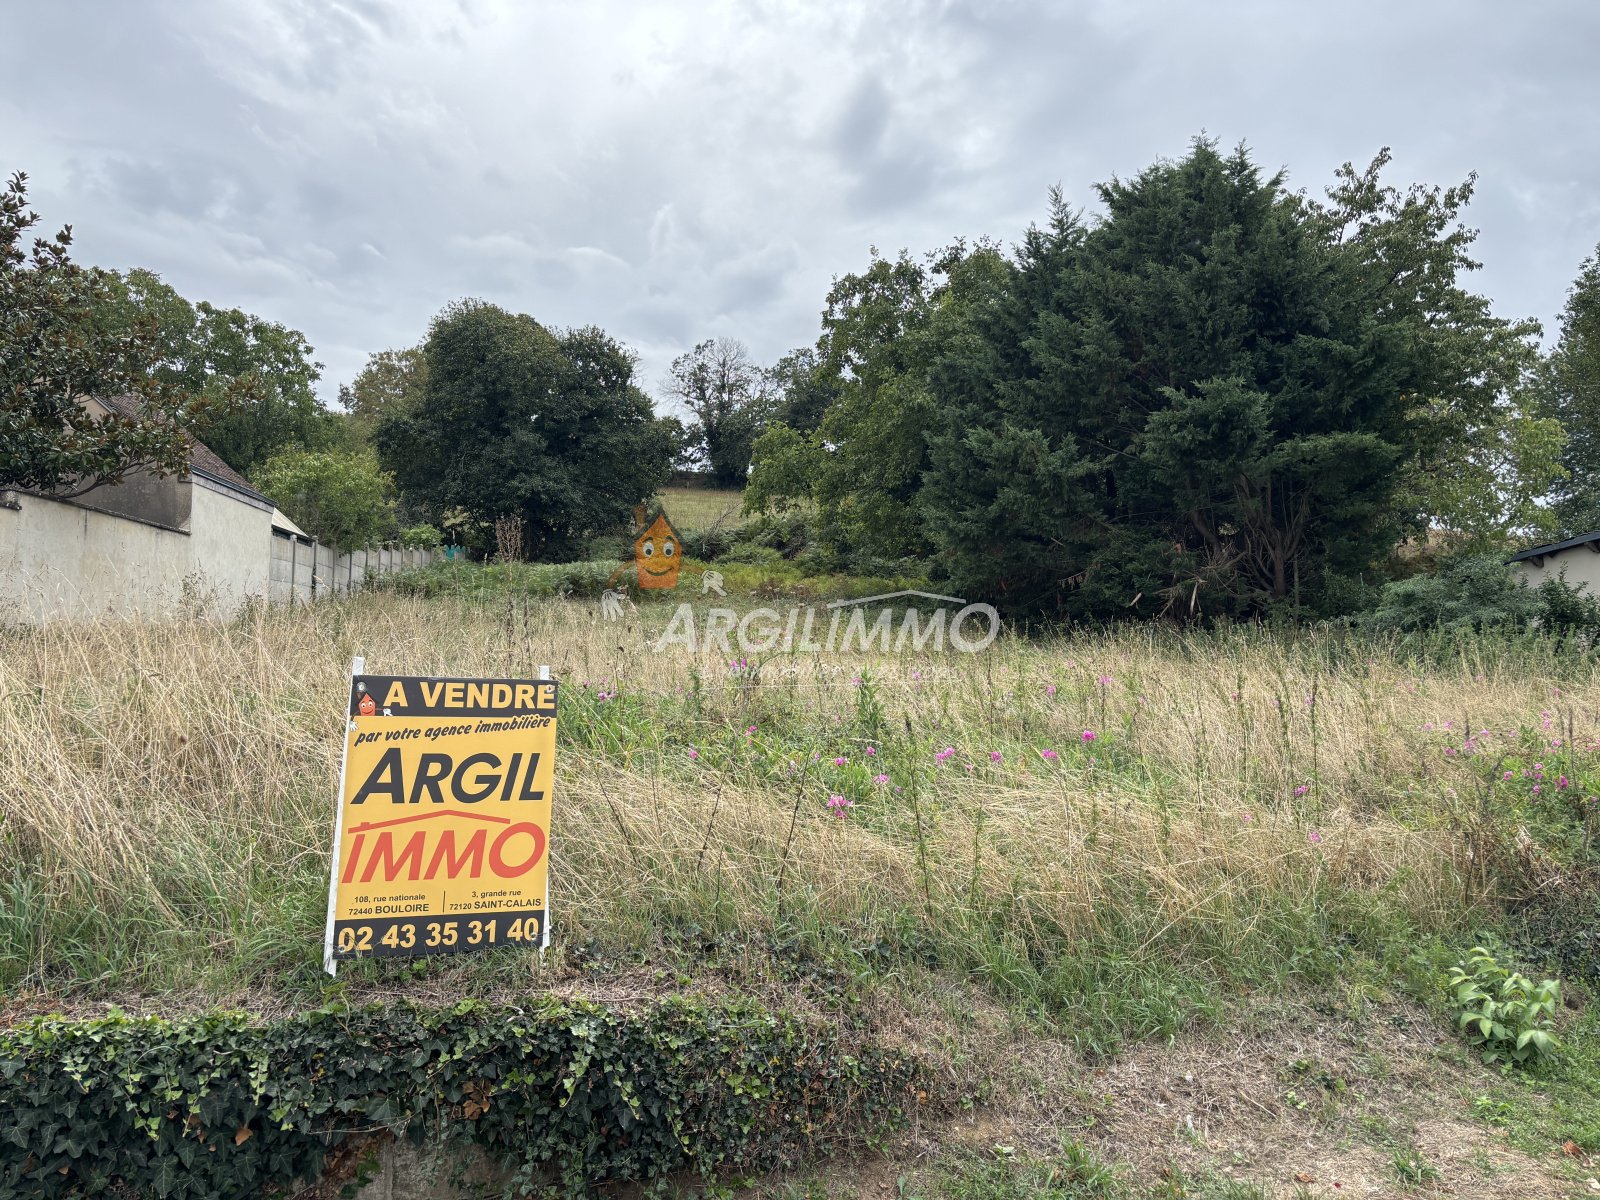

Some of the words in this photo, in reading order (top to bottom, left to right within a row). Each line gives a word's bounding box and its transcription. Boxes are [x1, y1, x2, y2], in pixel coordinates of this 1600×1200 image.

[383, 681, 408, 707] A
[420, 682, 555, 710] VENDRE
[354, 731, 383, 746] par
[384, 728, 421, 742] votre
[424, 724, 471, 741] agence
[475, 714, 550, 734] immobilière
[351, 747, 544, 804] ARGIL
[342, 821, 546, 883] IMMO
[355, 895, 371, 904] 108,
[373, 895, 386, 903] rue
[388, 893, 425, 902] nationale
[449, 902, 472, 910] 72120
[474, 898, 541, 909] SAINT-CALAIS
[472, 891, 478, 899] 3,
[481, 890, 508, 899] grande
[349, 907, 373, 915] 72440
[375, 904, 429, 914] BOULOIRE
[339, 926, 373, 952] 02
[382, 924, 415, 949] 43
[426, 922, 458, 946] 35
[467, 920, 499, 943] 31
[507, 918, 539, 941] 40
